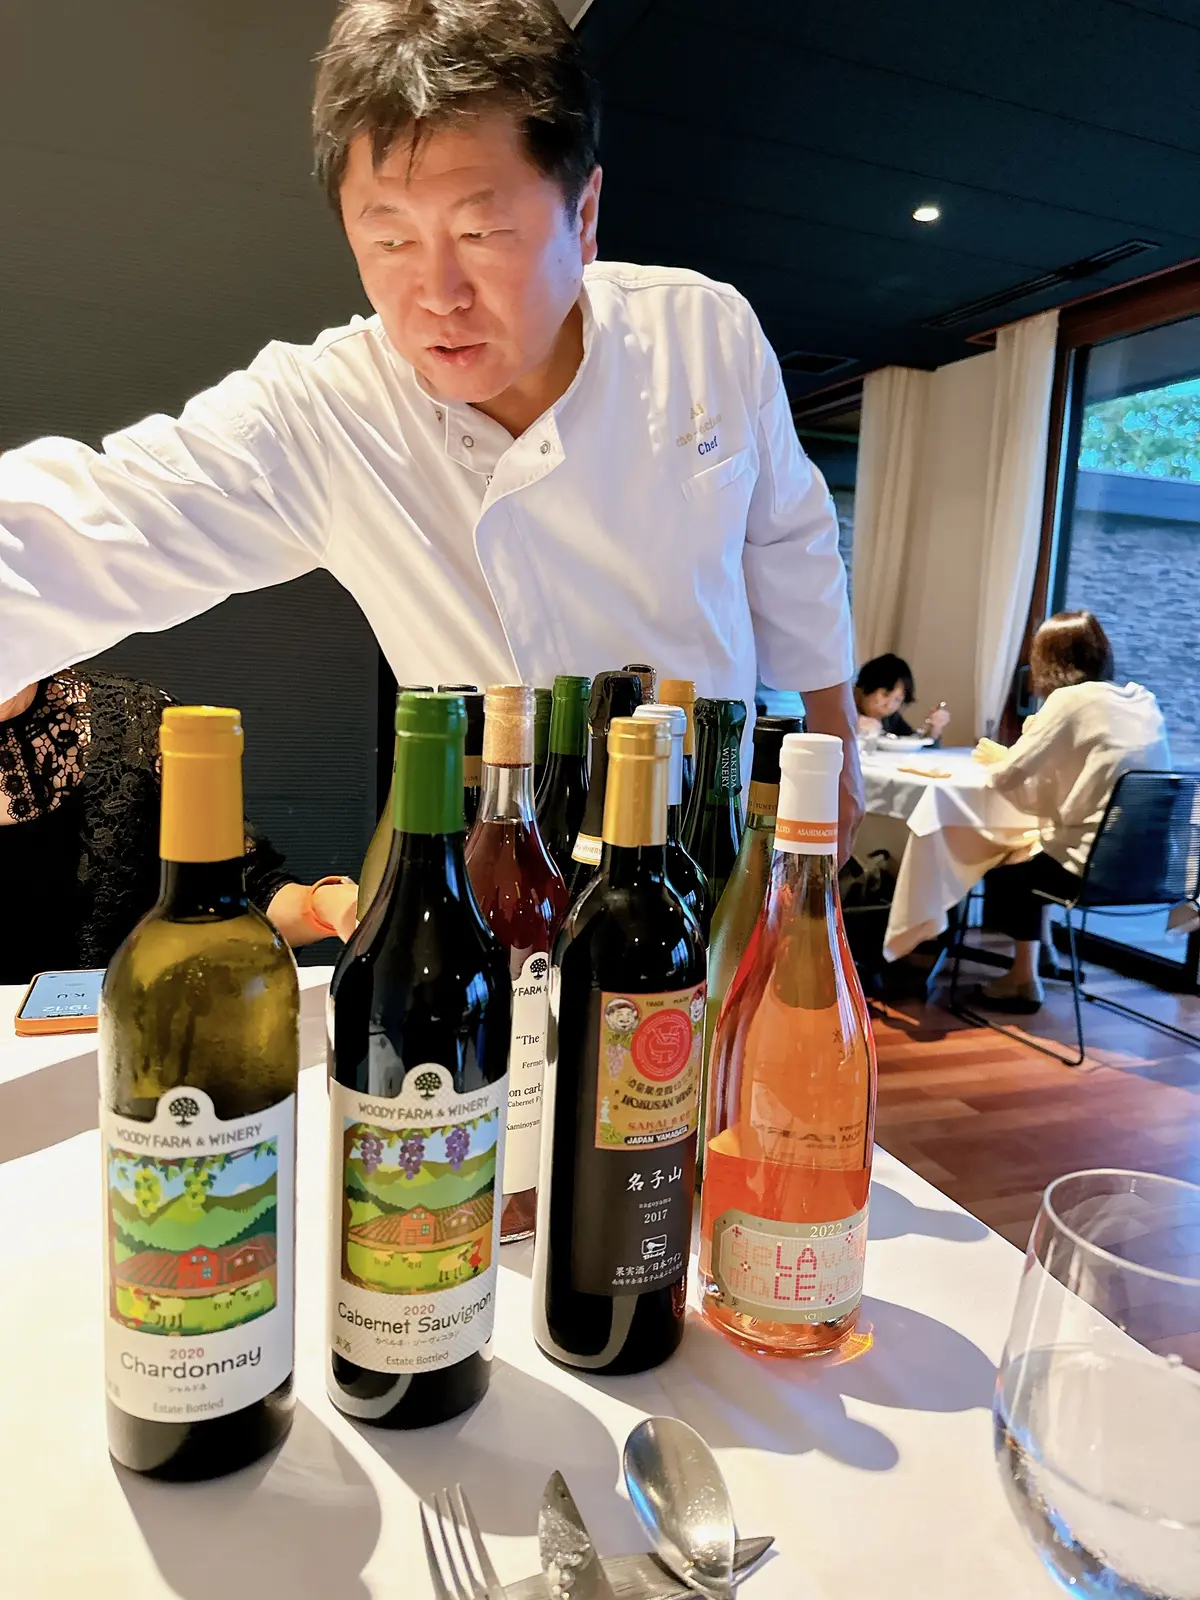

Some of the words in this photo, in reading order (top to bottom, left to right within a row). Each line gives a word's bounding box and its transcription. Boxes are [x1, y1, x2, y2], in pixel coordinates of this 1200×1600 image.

[697, 436, 718, 455] Chef
[722, 747, 730, 788] WINERY
[518, 985, 542, 997] FARM
[358, 1102, 396, 1120] WOODY
[397, 1107, 433, 1120] FARM
[437, 1109, 445, 1117] &
[449, 1096, 489, 1117] WINERY
[116, 1127, 152, 1148] WOODY
[153, 1136, 191, 1148] FARM
[196, 1138, 205, 1146] &
[209, 1123, 262, 1146] WINERY
[627, 1134, 655, 1144] JAPAN
[626, 1166, 682, 1191] 名子山
[644, 1209, 668, 1224] 2017
[810, 1223, 843, 1239] 2022
[338, 1302, 411, 1334] Cabernet
[418, 1292, 492, 1332] Sauvignon
[404, 1303, 435, 1316] 2020
[170, 1347, 205, 1360] 2020
[386, 1356, 414, 1366] Estate
[416, 1352, 449, 1365] Bottled
[121, 1346, 262, 1379] Chardonnay
[153, 1402, 183, 1414] Estate
[186, 1398, 224, 1414] Bottled
